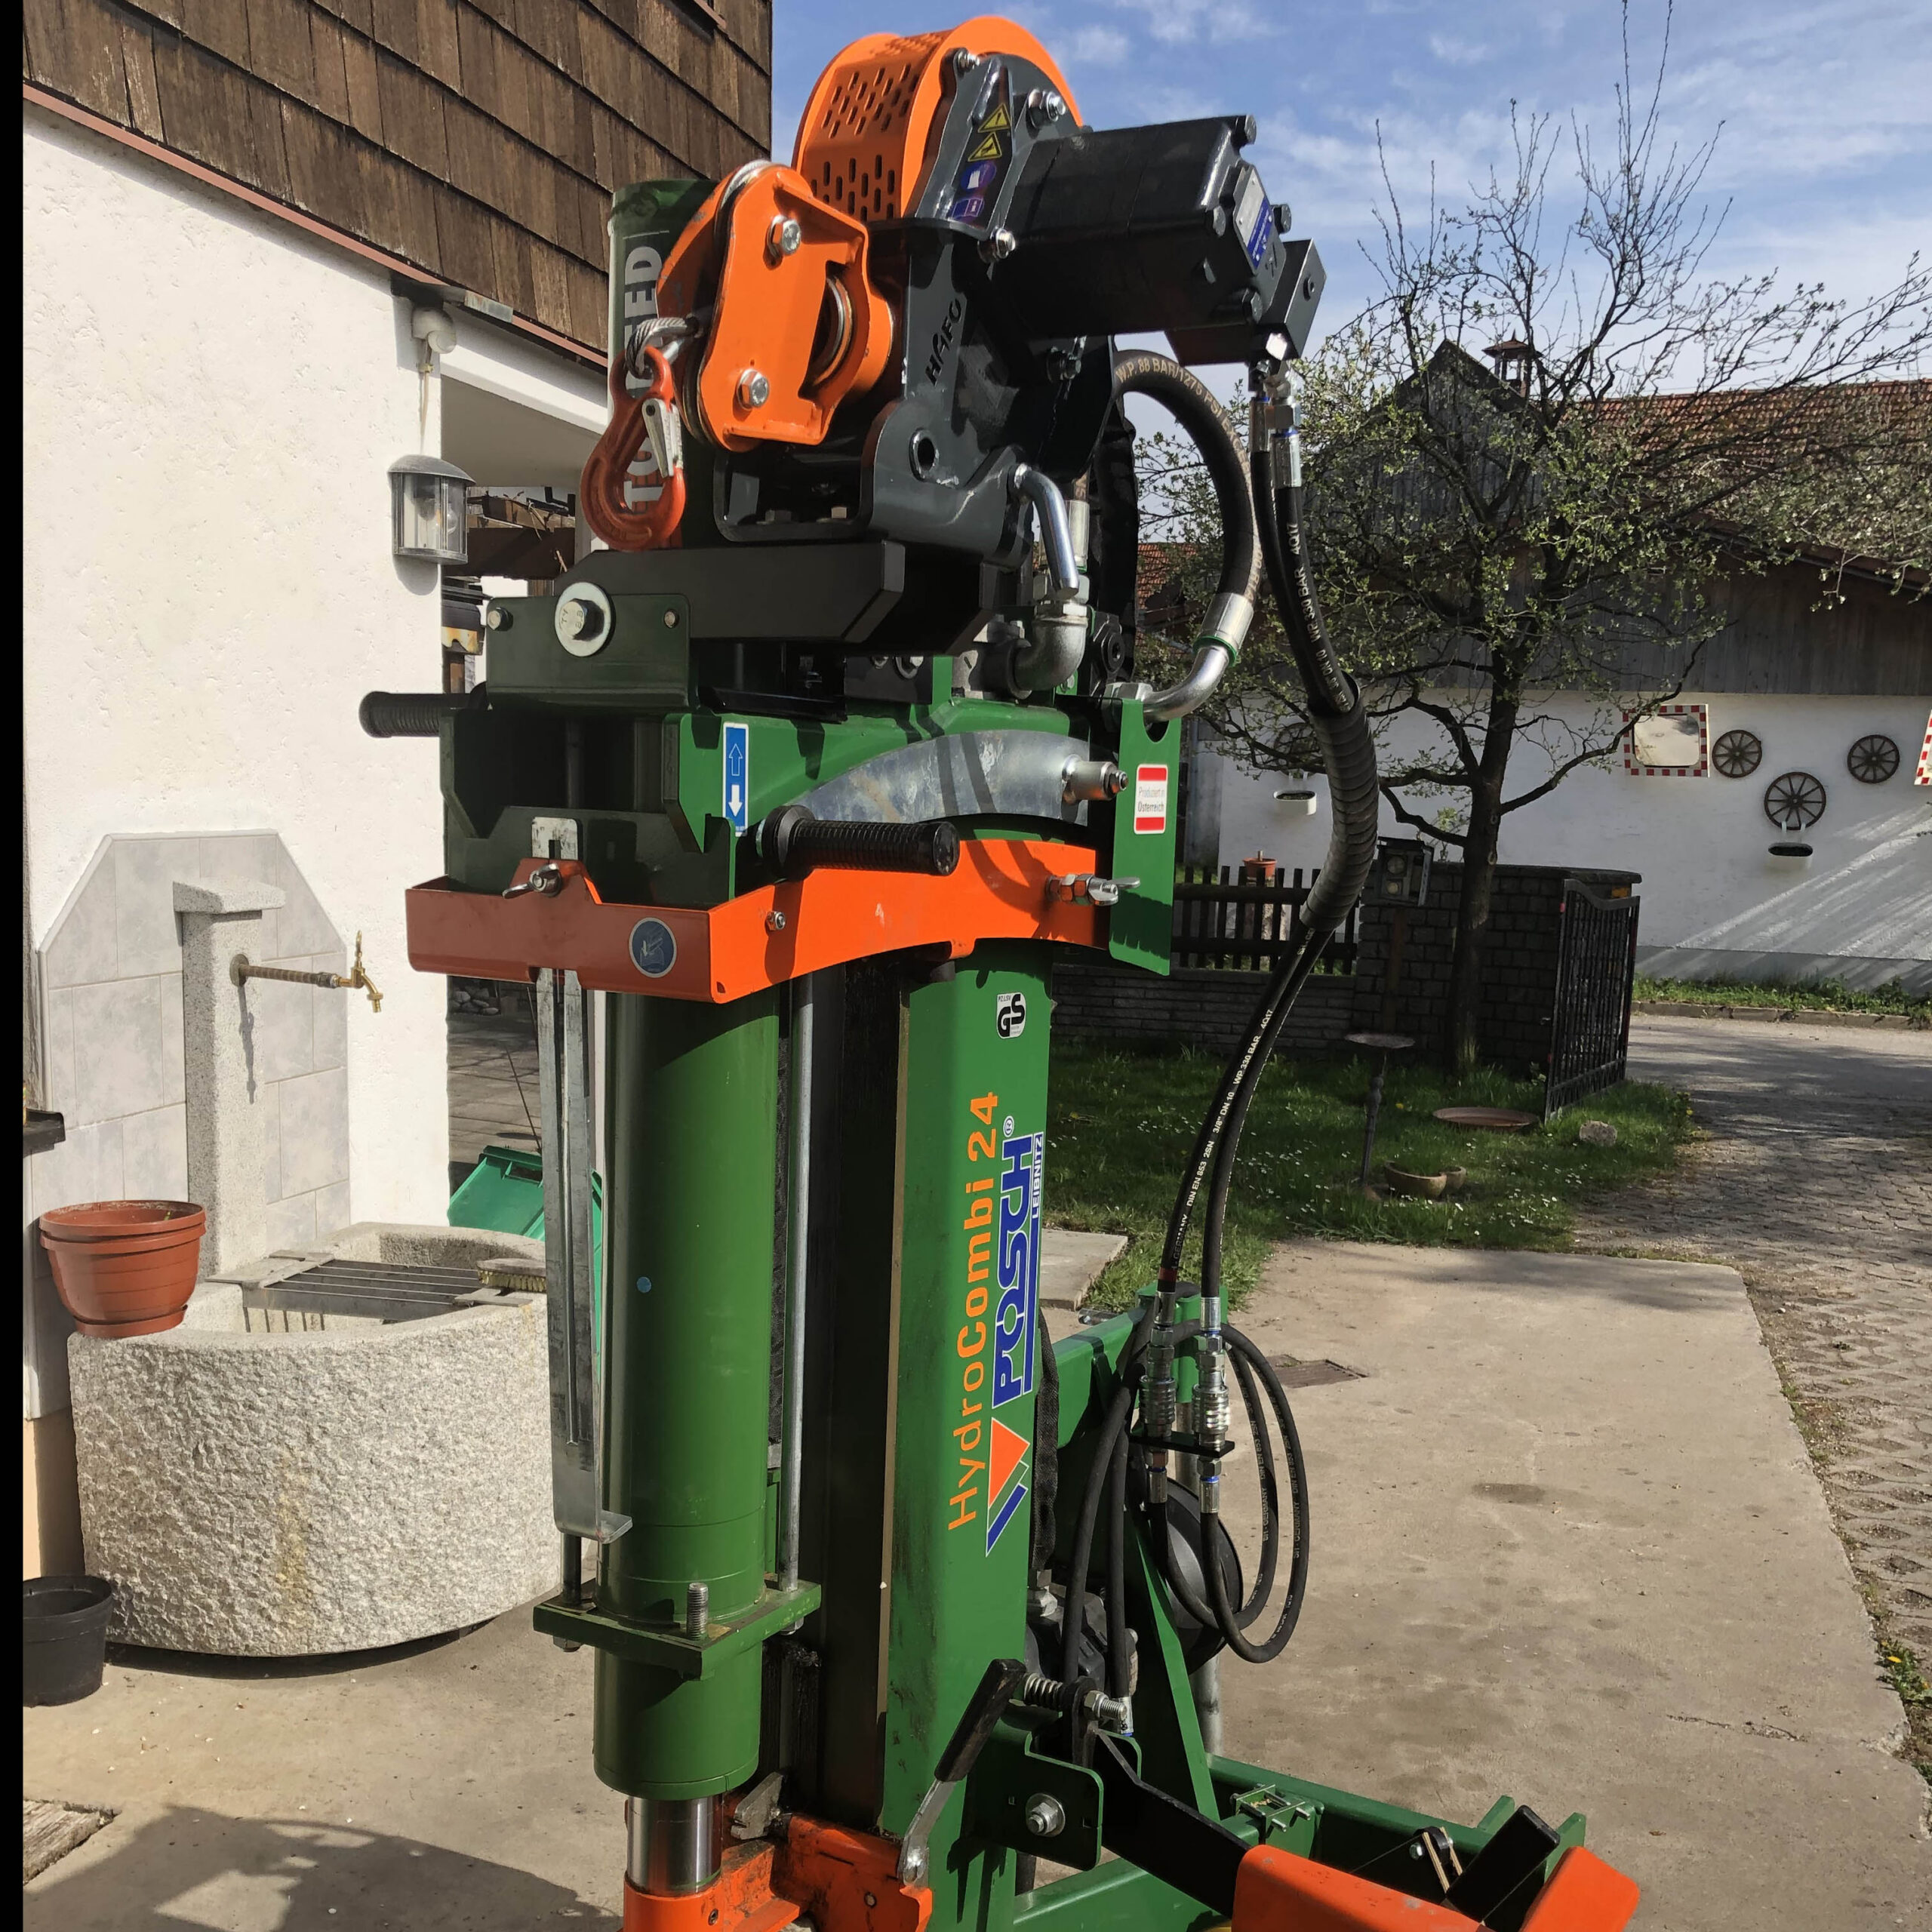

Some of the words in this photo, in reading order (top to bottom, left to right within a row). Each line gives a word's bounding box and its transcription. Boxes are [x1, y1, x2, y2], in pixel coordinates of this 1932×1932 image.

[925, 299, 961, 387] HAFO
[1137, 358, 1151, 374] 88
[1286, 523, 1301, 555] 4Q17
[1294, 564, 1309, 597] BAR
[1301, 598, 1315, 620] 330
[997, 993, 1026, 1038] GS
[967, 1091, 998, 1162] 24
[1186, 1191, 1197, 1208] DIN
[1192, 1177, 1201, 1190] EN
[1197, 1161, 1208, 1177] 853
[1203, 1140, 1215, 1158] 2SN
[1212, 1116, 1223, 1134] 3/8"
[1220, 1102, 1231, 1115] DN
[1226, 1091, 1235, 1101] 10
[1232, 1070, 1244, 1084] WP
[1240, 1055, 1251, 1069] 330
[1247, 1035, 1261, 1054] BAR
[1260, 1009, 1273, 1029] 4Q17
[1032, 1134, 1044, 1220] LEIBNITZ
[992, 1134, 1034, 1409] POSCH
[947, 1178, 994, 1530] HydroCombi
